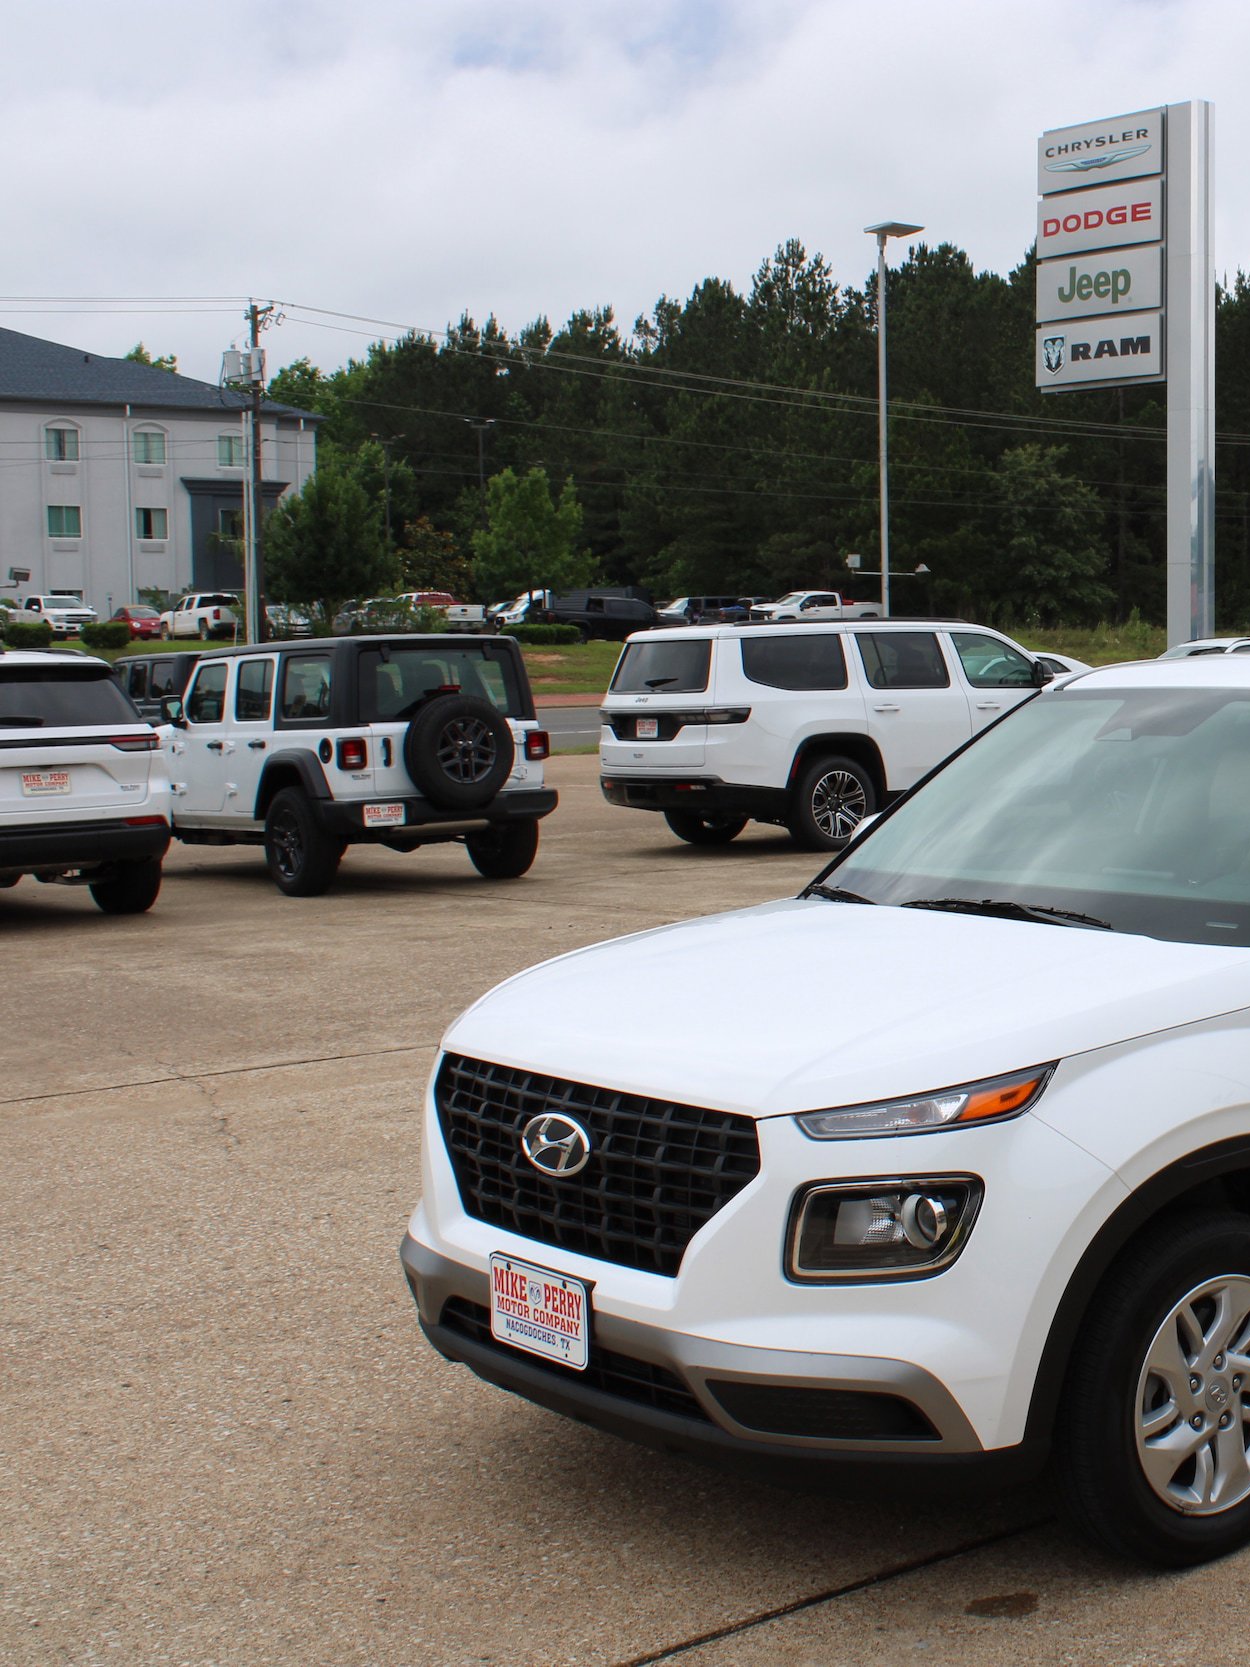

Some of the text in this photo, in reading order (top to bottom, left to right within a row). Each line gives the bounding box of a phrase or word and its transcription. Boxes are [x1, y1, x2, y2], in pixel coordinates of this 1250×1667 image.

[1045, 128, 1149, 158] CHRYSLER
[1043, 202, 1152, 238] DODGE
[1058, 266, 1131, 304] Jeep
[1071, 335, 1151, 362] RAM
[22, 774, 41, 783] MIKE
[493, 1266, 582, 1321] MIKE PERRY
[497, 1295, 580, 1336] MOTOR COMPANY
[560, 1337, 571, 1351] TX
